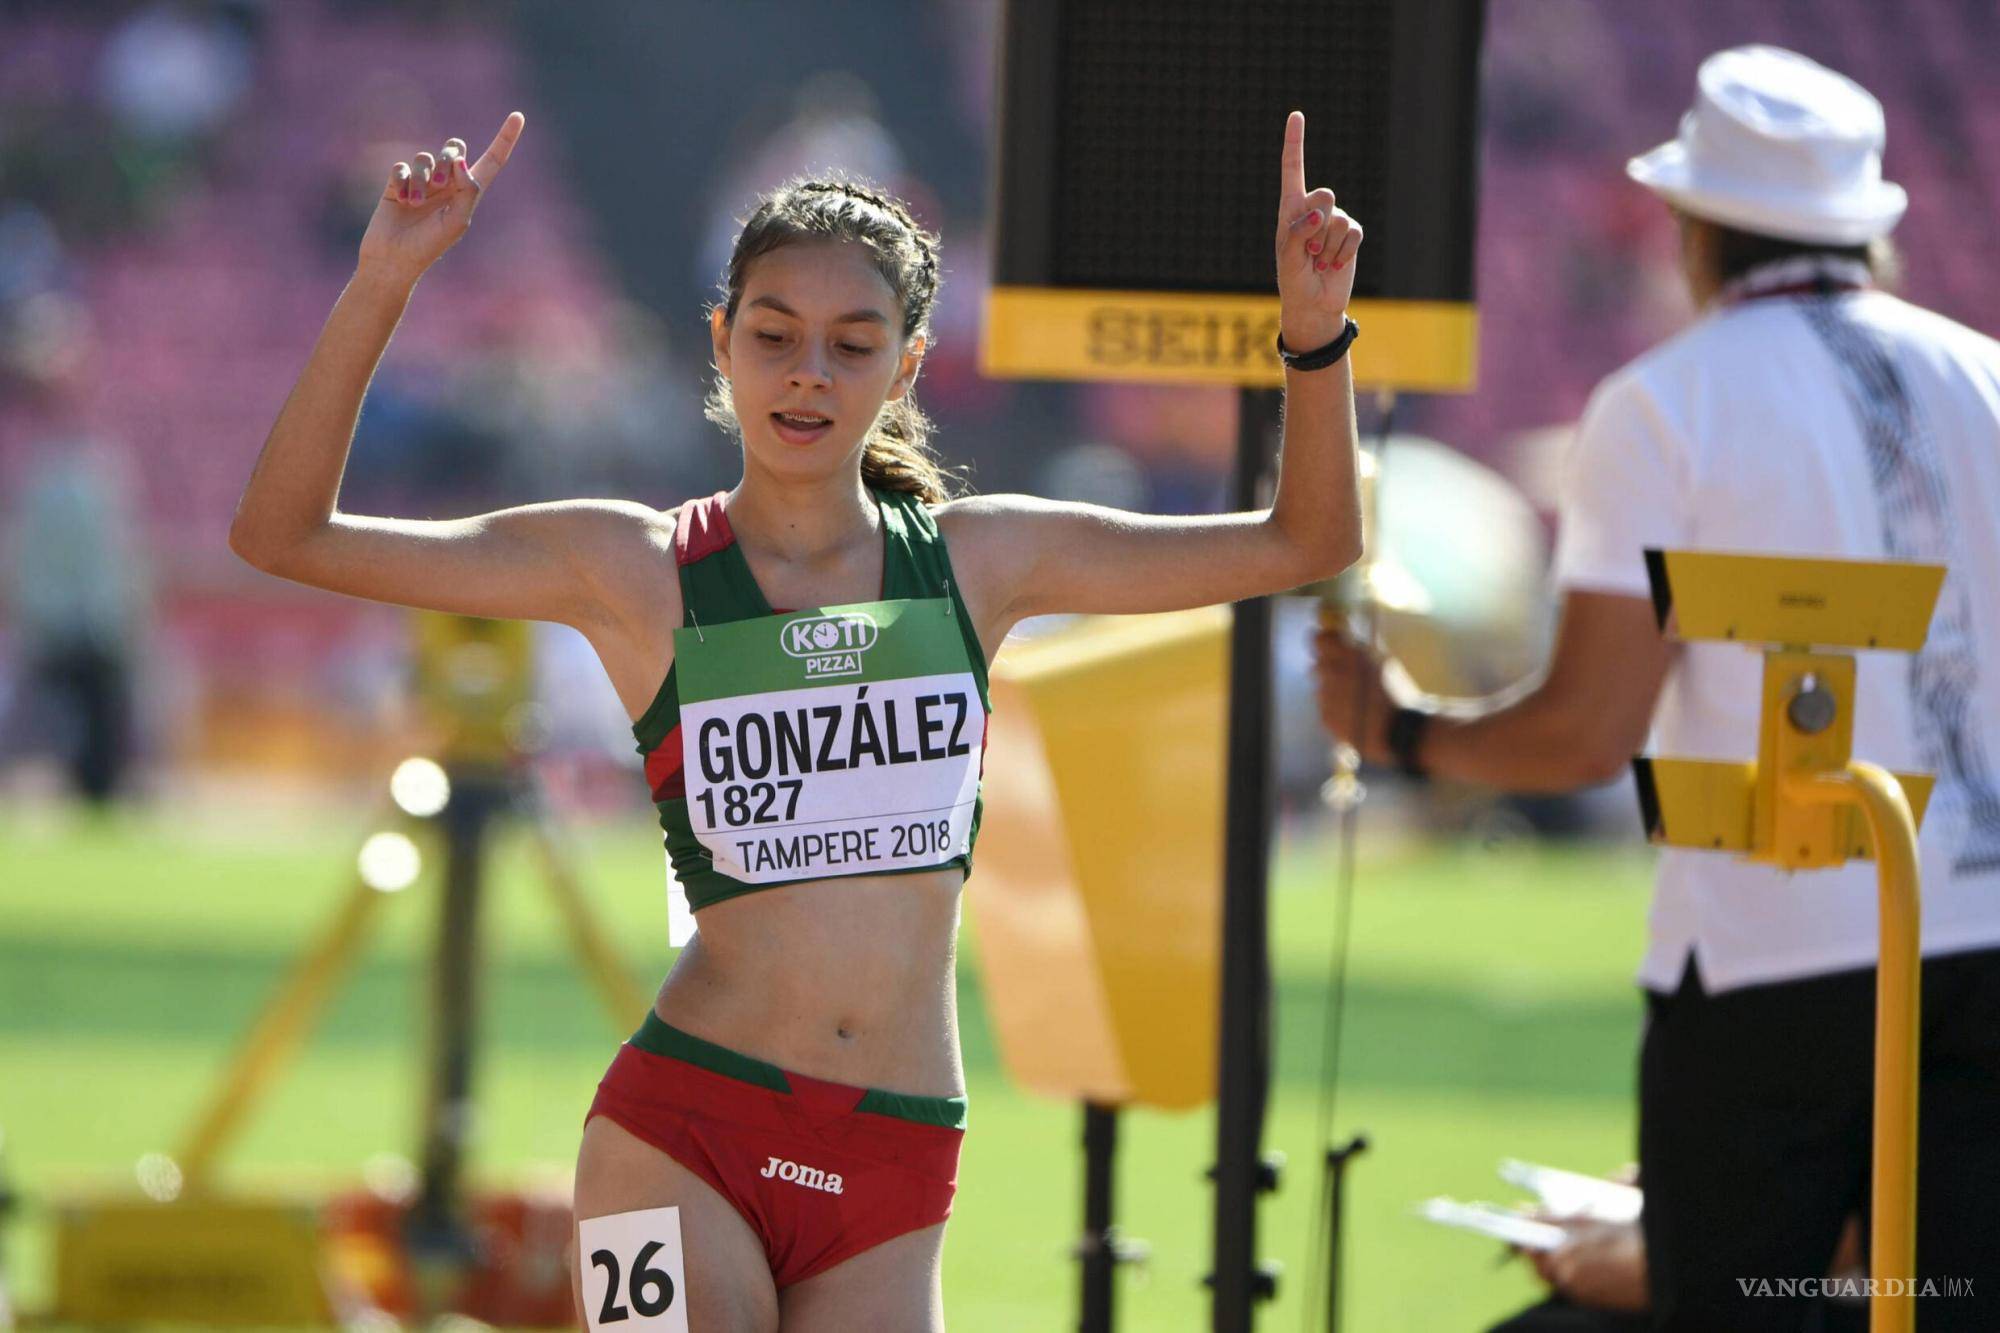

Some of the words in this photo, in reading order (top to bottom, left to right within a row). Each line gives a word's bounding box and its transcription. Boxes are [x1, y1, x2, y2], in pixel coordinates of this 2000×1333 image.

[1086, 307, 1281, 367] SEIK
[792, 618, 866, 652] KOTI
[806, 654, 856, 673] PIZZA
[699, 686, 970, 783] GONZÁLEZ
[696, 780, 803, 829] 1827
[736, 828, 881, 873] TAMPERE
[891, 820, 951, 857] 2018
[590, 1241, 675, 1324] 26
